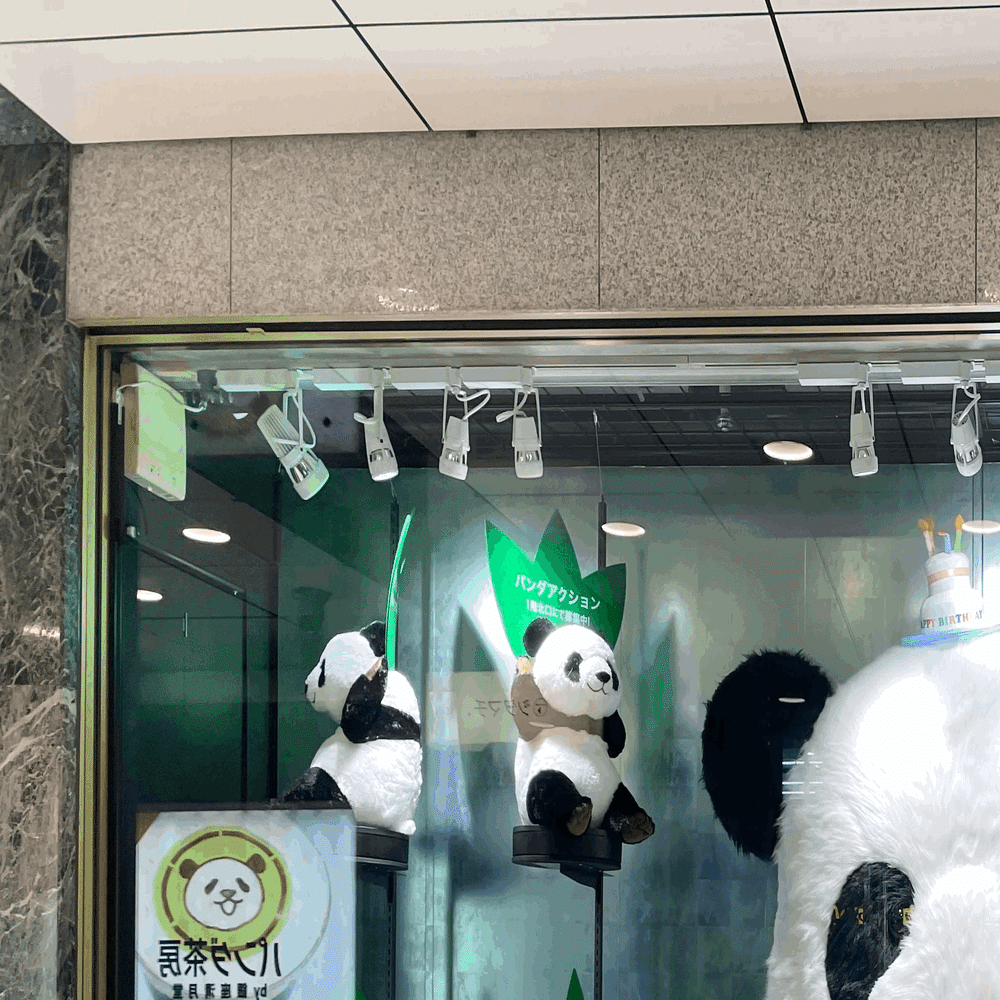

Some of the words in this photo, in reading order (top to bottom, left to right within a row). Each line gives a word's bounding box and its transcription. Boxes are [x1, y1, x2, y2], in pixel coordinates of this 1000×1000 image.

[515, 574, 600, 610] パンダアクション
[938, 610, 983, 626] BIRTHAY
